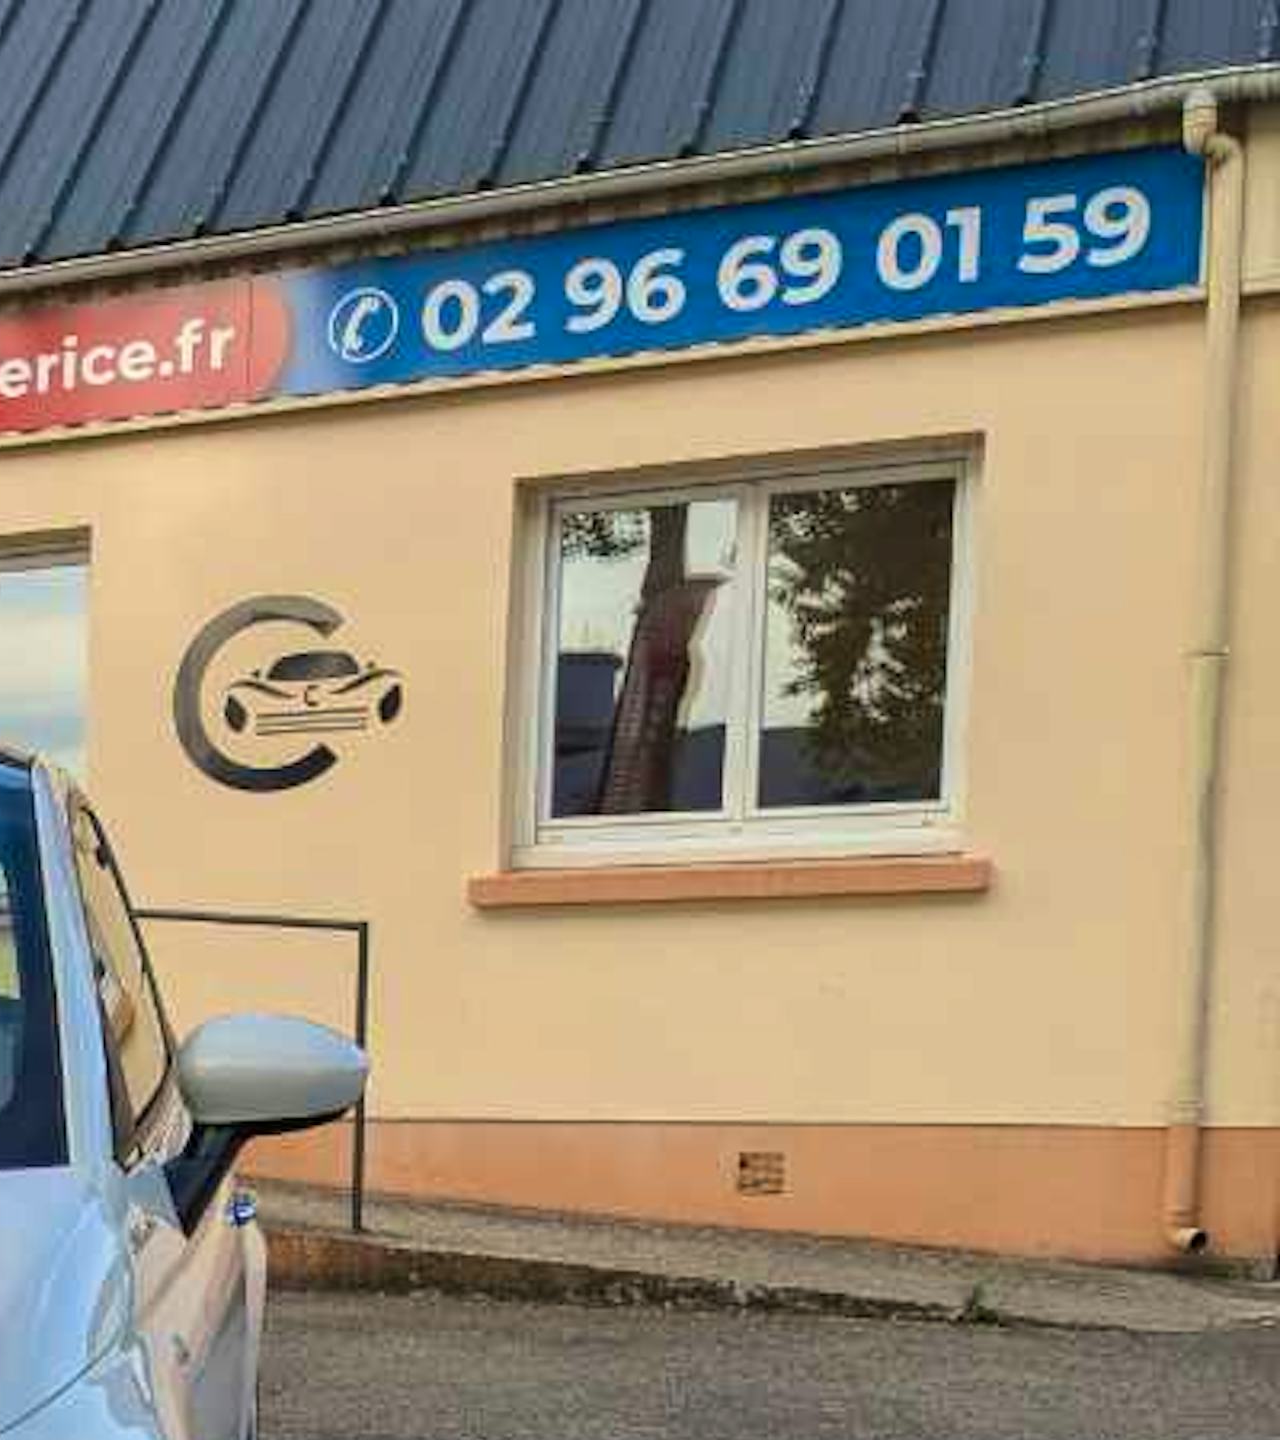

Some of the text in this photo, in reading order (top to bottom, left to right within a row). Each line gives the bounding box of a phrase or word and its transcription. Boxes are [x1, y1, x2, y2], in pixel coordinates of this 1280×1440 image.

[419, 185, 1153, 352] 02 96 69 01 59
